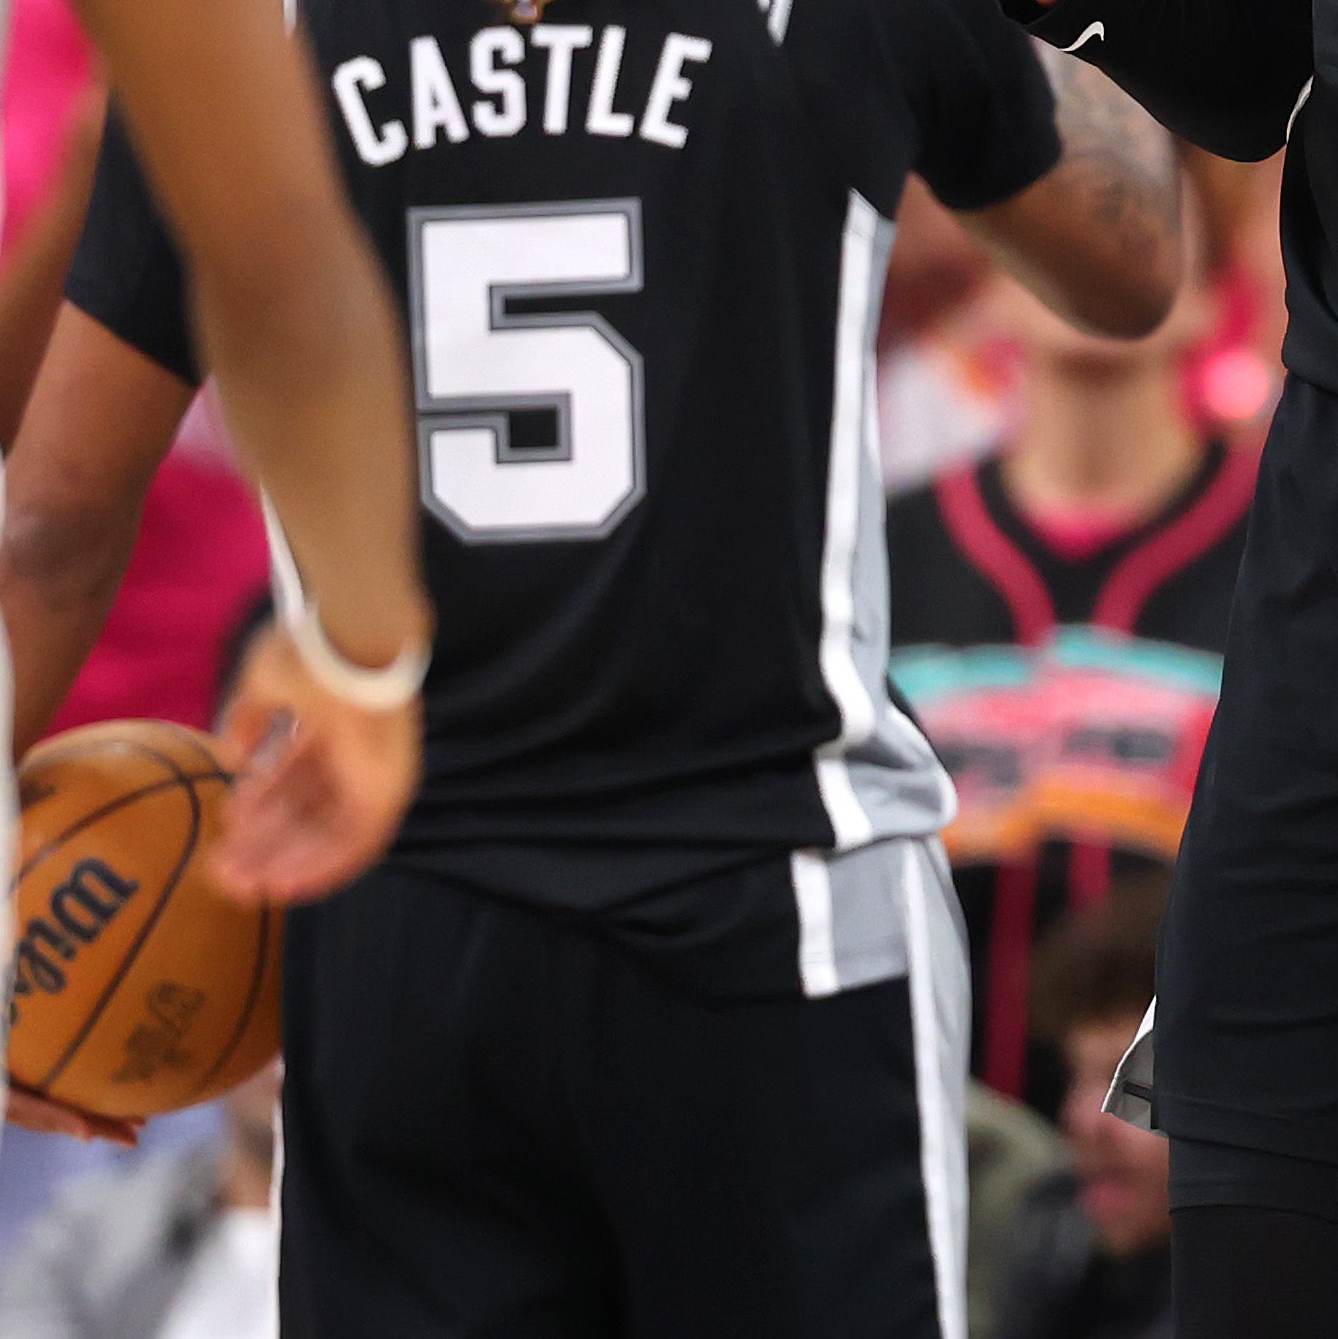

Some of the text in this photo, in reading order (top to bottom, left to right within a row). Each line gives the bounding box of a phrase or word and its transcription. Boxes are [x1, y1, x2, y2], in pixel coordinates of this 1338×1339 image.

[331, 23, 714, 166] CASTLE
[406, 196, 649, 546] 5
[7, 857, 141, 1028] Wil
